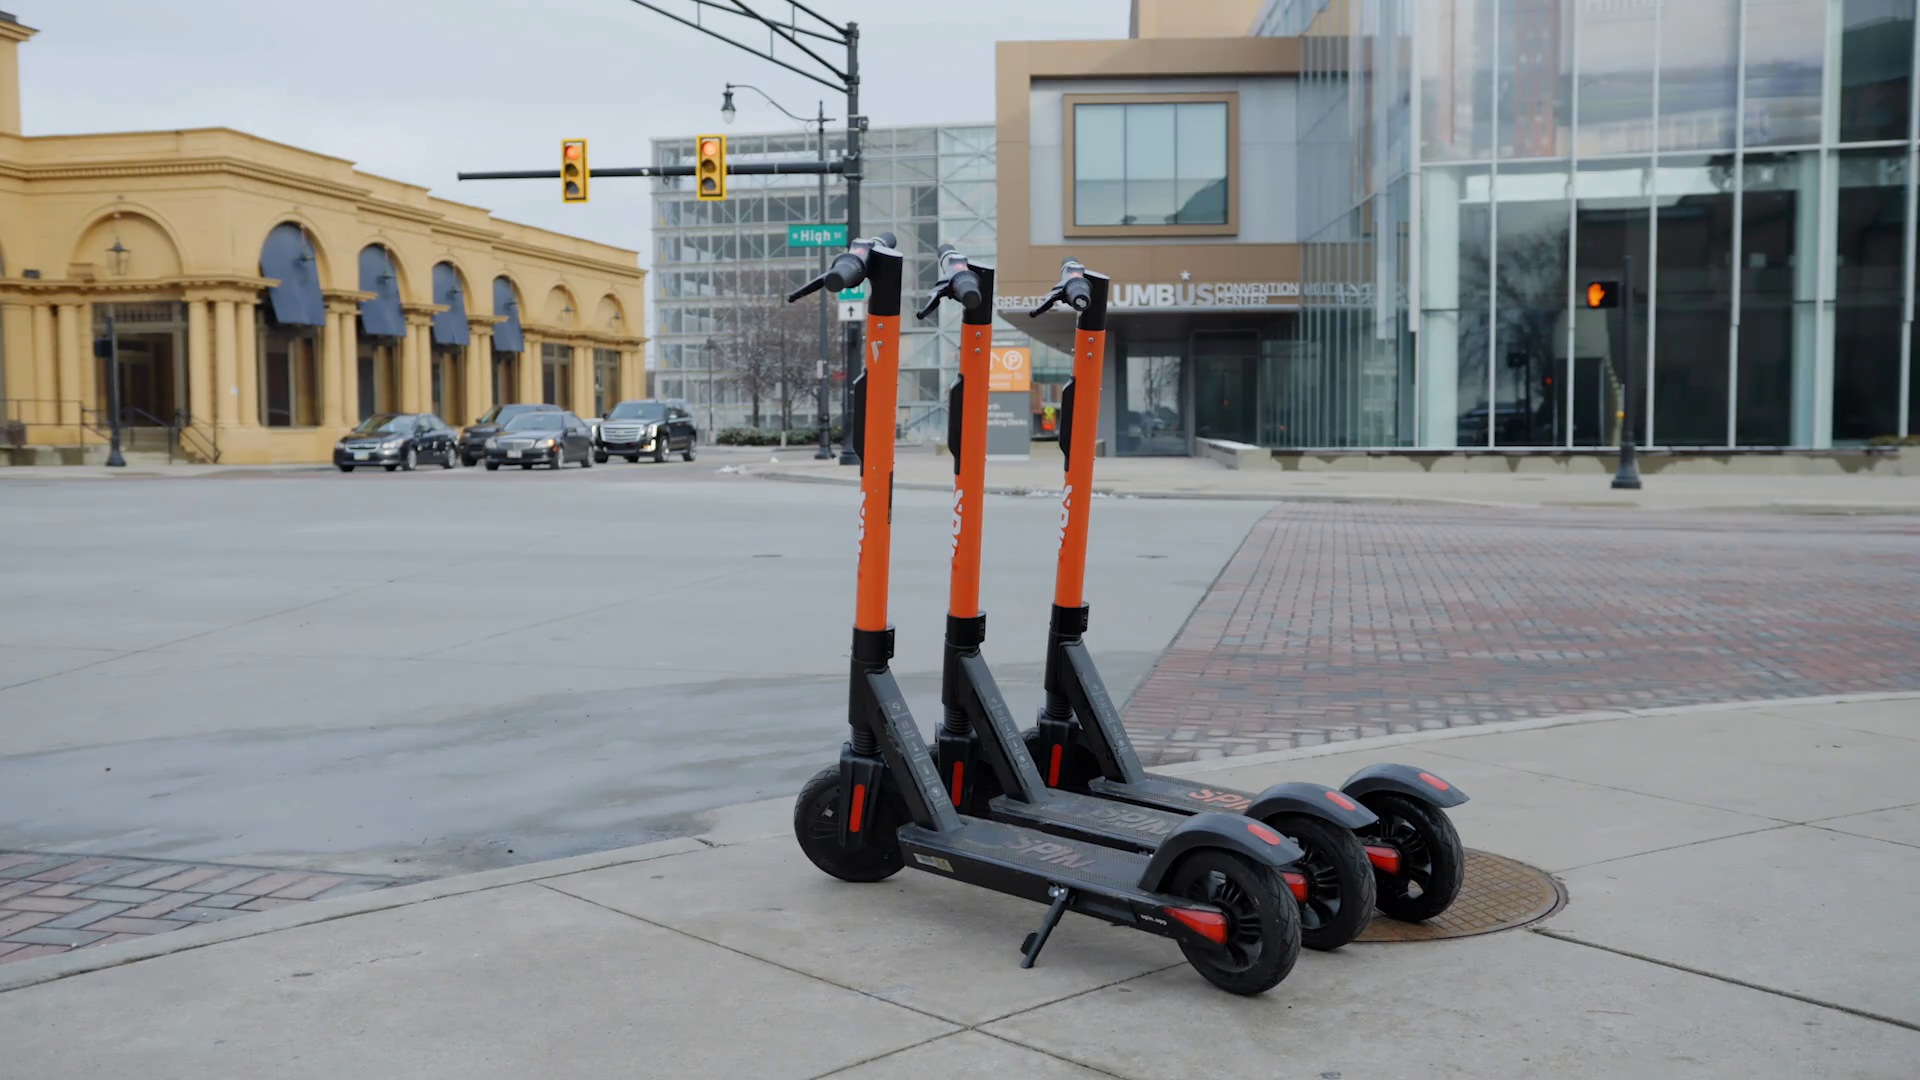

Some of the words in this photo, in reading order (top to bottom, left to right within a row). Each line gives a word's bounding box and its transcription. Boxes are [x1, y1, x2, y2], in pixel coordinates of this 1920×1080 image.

[800, 230, 831, 245] High
[997, 295, 1047, 307] GREATE
[1107, 284, 1215, 306] UMBUS
[1215, 282, 1299, 296] CONVENTION
[1215, 294, 1268, 306] CENTER
[1091, 807, 1179, 835] SPIN
[1002, 836, 1097, 868] SPIN
